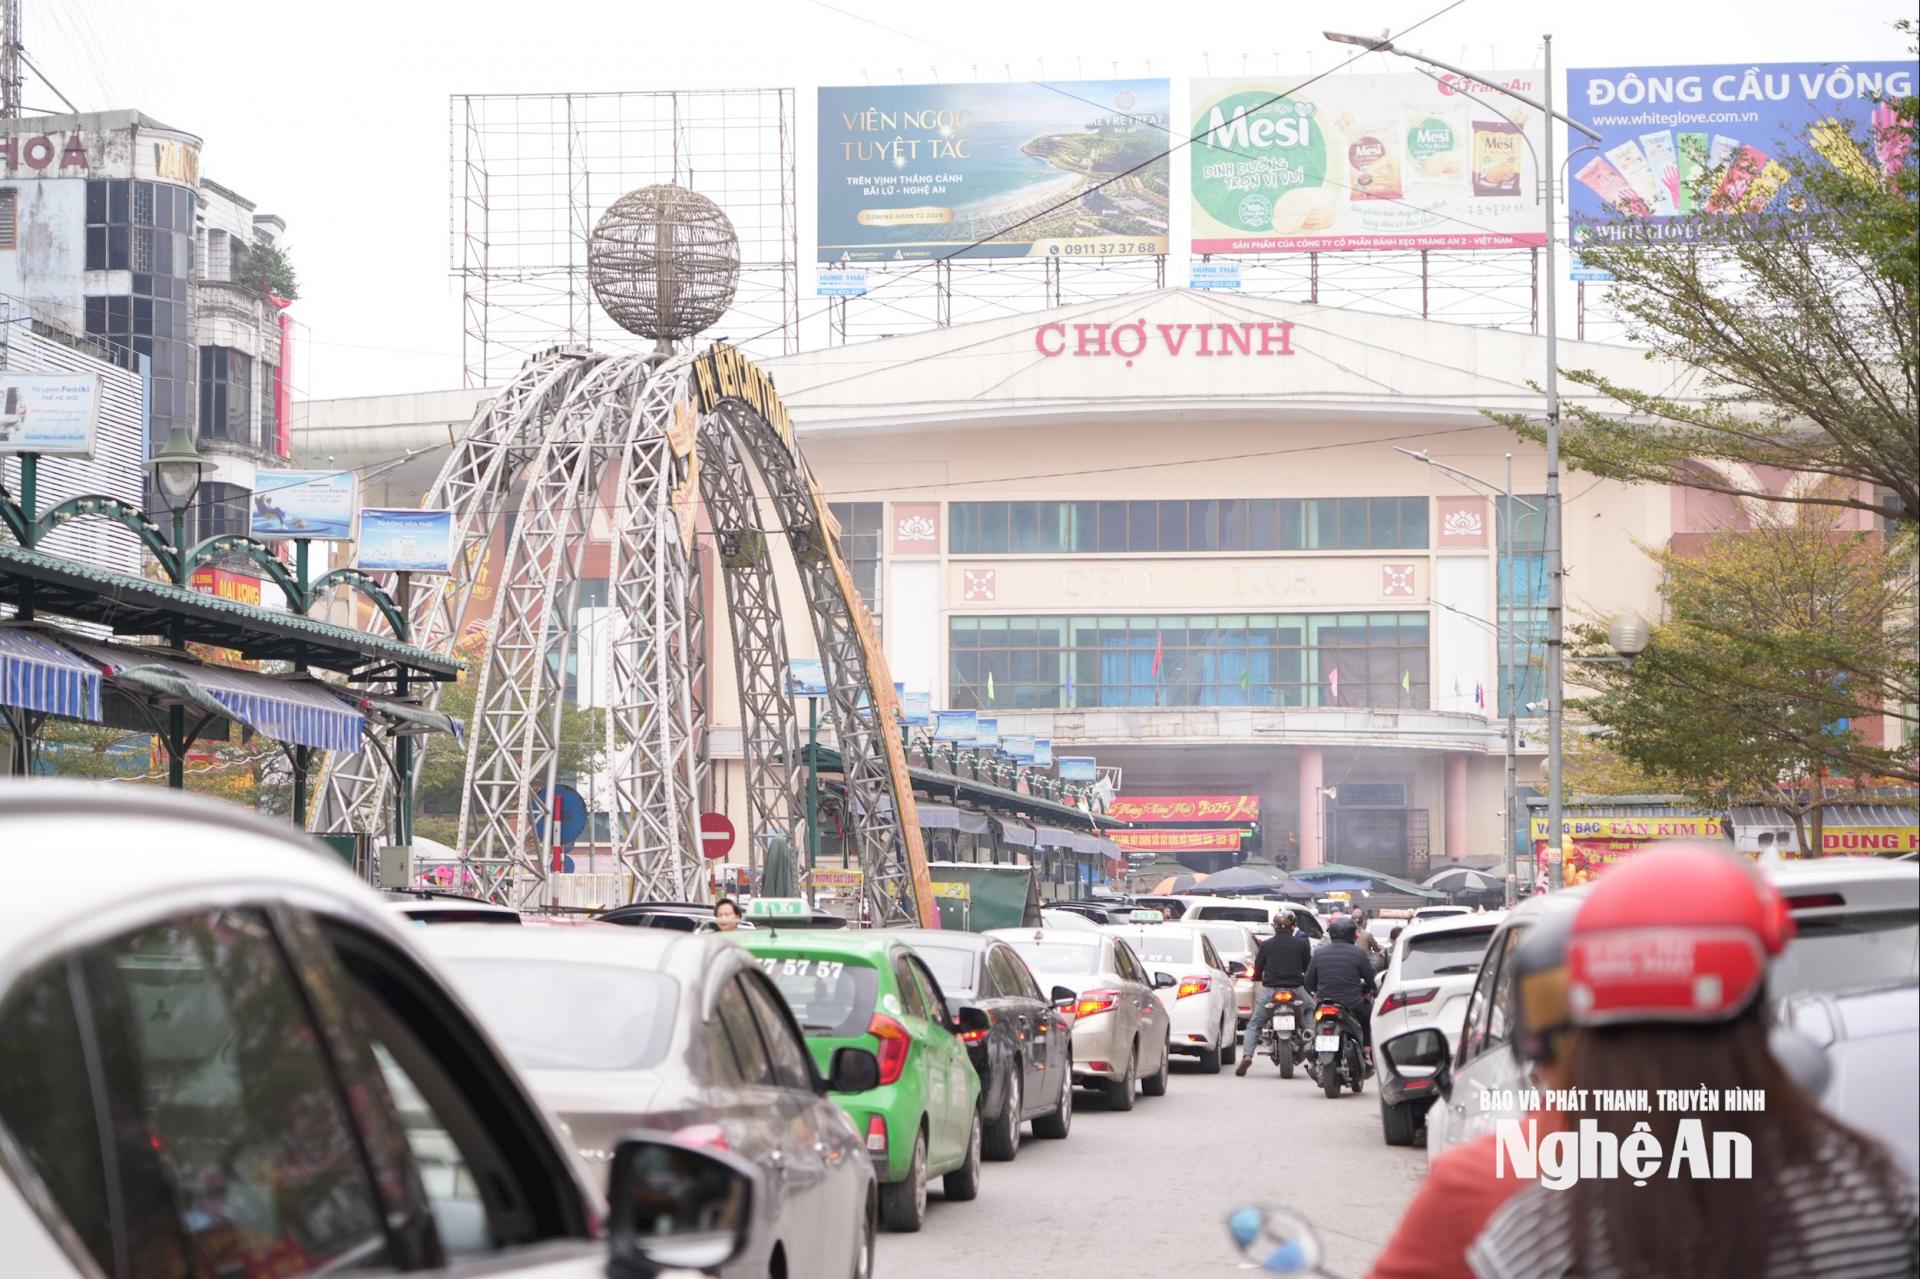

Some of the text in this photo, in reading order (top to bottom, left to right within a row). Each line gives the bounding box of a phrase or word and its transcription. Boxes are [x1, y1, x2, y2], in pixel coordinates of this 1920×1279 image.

[842, 106, 897, 132] VIÊN
[1206, 101, 1314, 149] Mesi
[1592, 110, 1758, 127] www.whiteglove.com.vn
[1417, 128, 1449, 142] Mesi
[1484, 136, 1513, 150] Mesi
[841, 134, 972, 163] TUYỆT TÁC
[1356, 144, 1382, 157] Mesi
[1203, 161, 1235, 179] DINH
[846, 174, 871, 185] TRÊN
[903, 184, 930, 195] NGHỆ
[932, 185, 946, 194] AN
[1064, 242, 1156, 255] 0911 37 37 68
[1277, 239, 1296, 248] CỦA
[1297, 238, 1320, 248] CÔNG
[1322, 239, 1332, 247] TY
[1373, 237, 1397, 246] BÁNH
[1447, 237, 1460, 245] AN
[1462, 237, 1467, 245] 2
[1474, 235, 1493, 245] VIỆT
[1494, 236, 1513, 245] NAM
[1035, 318, 1295, 367] CHỢ VINH
[1575, 822, 1600, 836] BẠC
[1610, 820, 1649, 835] TÂN
[1657, 823, 1696, 836] KIM
[782, 958, 811, 977] 57
[815, 960, 844, 979] 57
